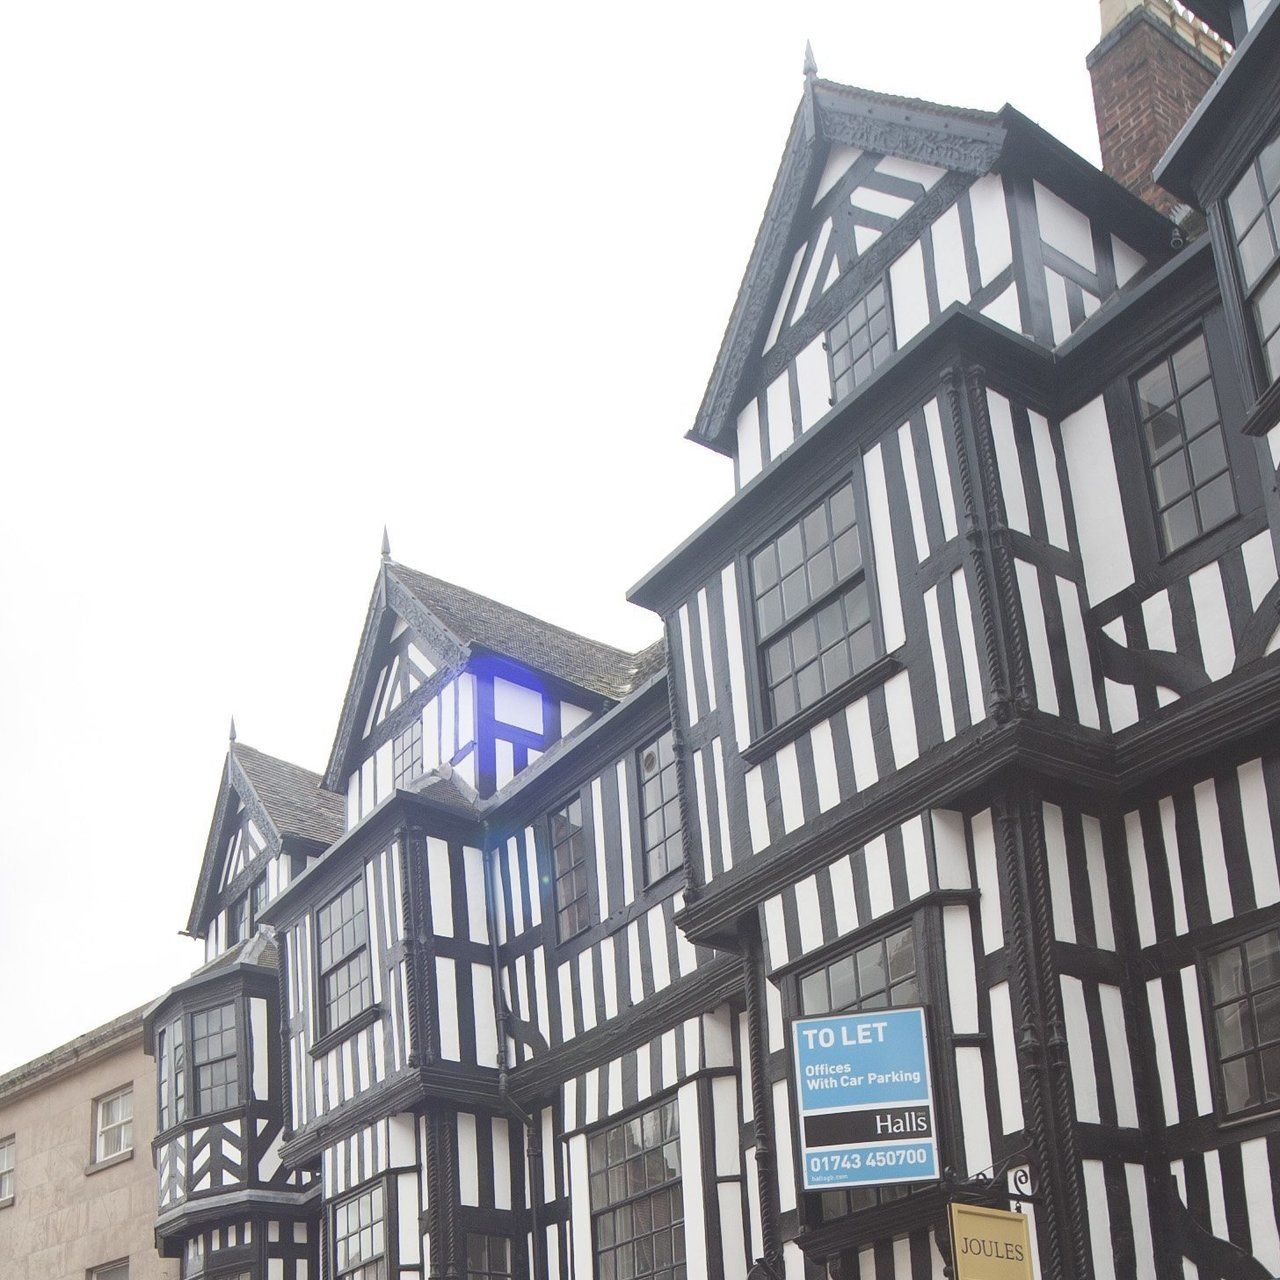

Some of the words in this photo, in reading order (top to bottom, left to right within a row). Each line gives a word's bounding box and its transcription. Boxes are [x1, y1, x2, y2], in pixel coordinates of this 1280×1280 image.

[803, 1028, 835, 1049] TO
[841, 1022, 888, 1046] LET
[805, 1062, 852, 1077] Offices
[807, 1077, 838, 1091] With
[840, 1075, 864, 1088] Car
[867, 1070, 921, 1085] Parking
[875, 1111, 928, 1135] Halls
[810, 1154, 862, 1173] 01743
[865, 1148, 927, 1168] 450700
[961, 1237, 1024, 1262] JOULES
